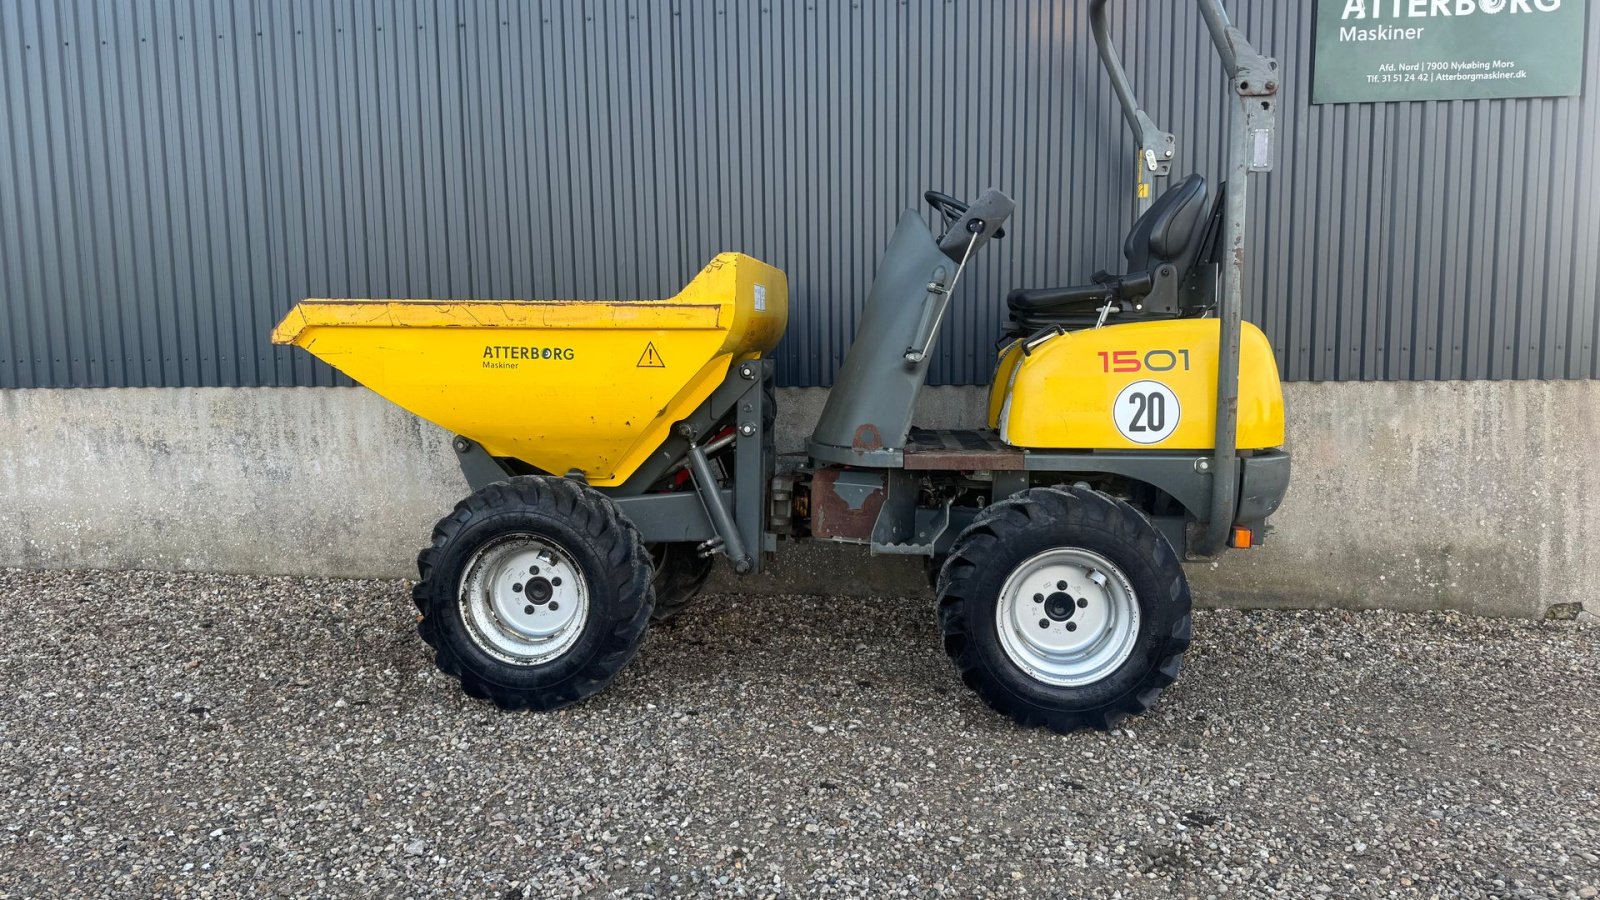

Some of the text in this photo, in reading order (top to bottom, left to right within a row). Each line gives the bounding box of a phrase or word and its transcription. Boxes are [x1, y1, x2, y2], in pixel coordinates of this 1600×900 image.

[1339, 24, 1424, 42] Maskiner
[1378, 63, 1396, 72] Afd.
[1398, 61, 1420, 71] Nord
[1426, 61, 1449, 71] 7900
[1450, 61, 1490, 71] Nykøbing
[1492, 59, 1515, 68] Mors
[1366, 74, 1380, 83] Tlf.
[1381, 74, 1391, 83] 31
[1393, 74, 1402, 82] 51
[1404, 73, 1415, 82] 24
[1417, 73, 1429, 81] 42
[1435, 70, 1527, 82] Atterborgmaskiner.dk
[482, 345, 575, 360] ATTERBORG
[482, 361, 519, 369] Maskiner
[1098, 349, 1190, 373] 1501
[1128, 391, 1165, 432] 20
